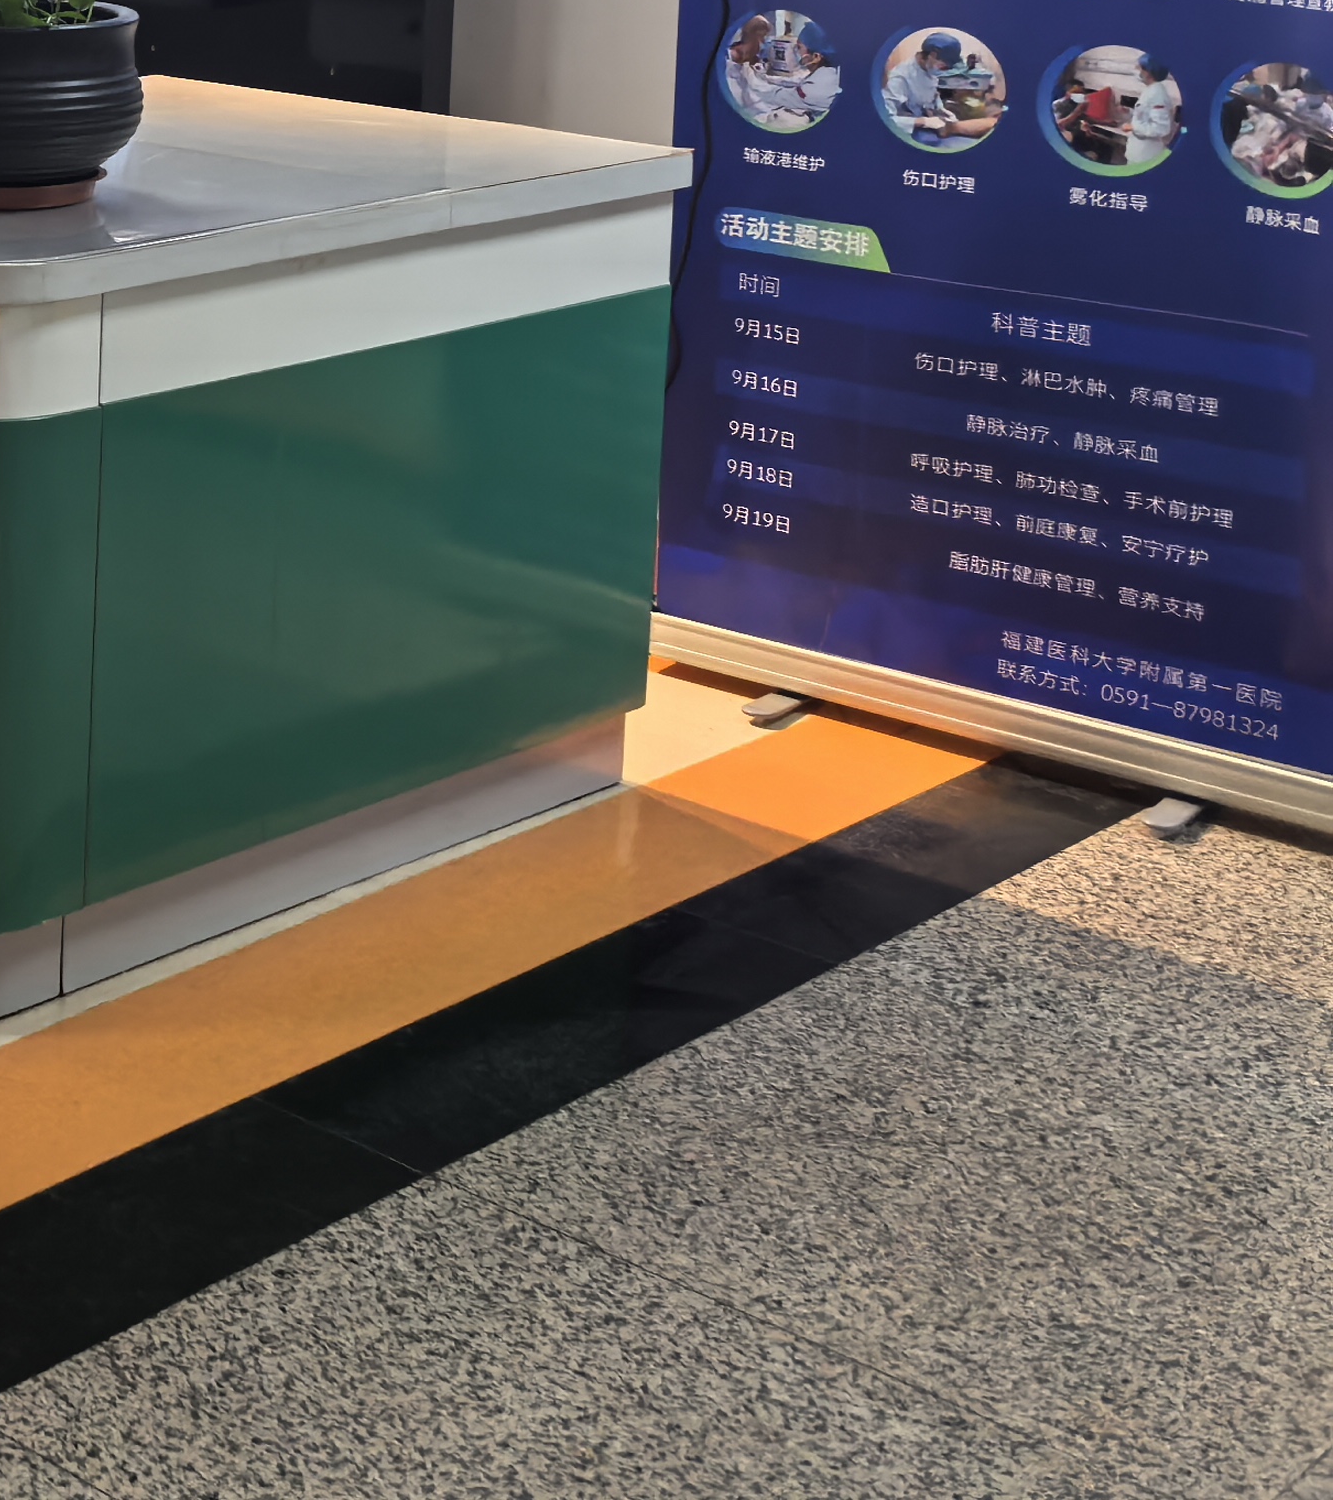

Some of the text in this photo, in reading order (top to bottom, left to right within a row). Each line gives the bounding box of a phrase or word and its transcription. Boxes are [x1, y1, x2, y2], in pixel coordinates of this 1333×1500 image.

[742, 146, 826, 173] 输液港维护
[901, 168, 976, 194] 伤口护理
[1068, 186, 1150, 213] 雾化指导
[719, 212, 871, 258] 活动主题安排
[1246, 204, 1321, 236] 静脉采血
[738, 273, 781, 298] 时间
[990, 311, 1093, 348] 科普主题
[734, 316, 1220, 417] 9月15日 伤口护理、淋巴水肿、疼痛管理
[731, 368, 1160, 464] 9月16日 静脉治疗、静脉采血
[726, 457, 794, 489] 9月18日
[728, 419, 1235, 530] 9月17日 呼吸护理、肺功检查、手术前护理
[721, 502, 1206, 623] 9月19日 脂肪肝健康管理、营养支持
[1001, 629, 1284, 713] 福建医科大学附属第一医院
